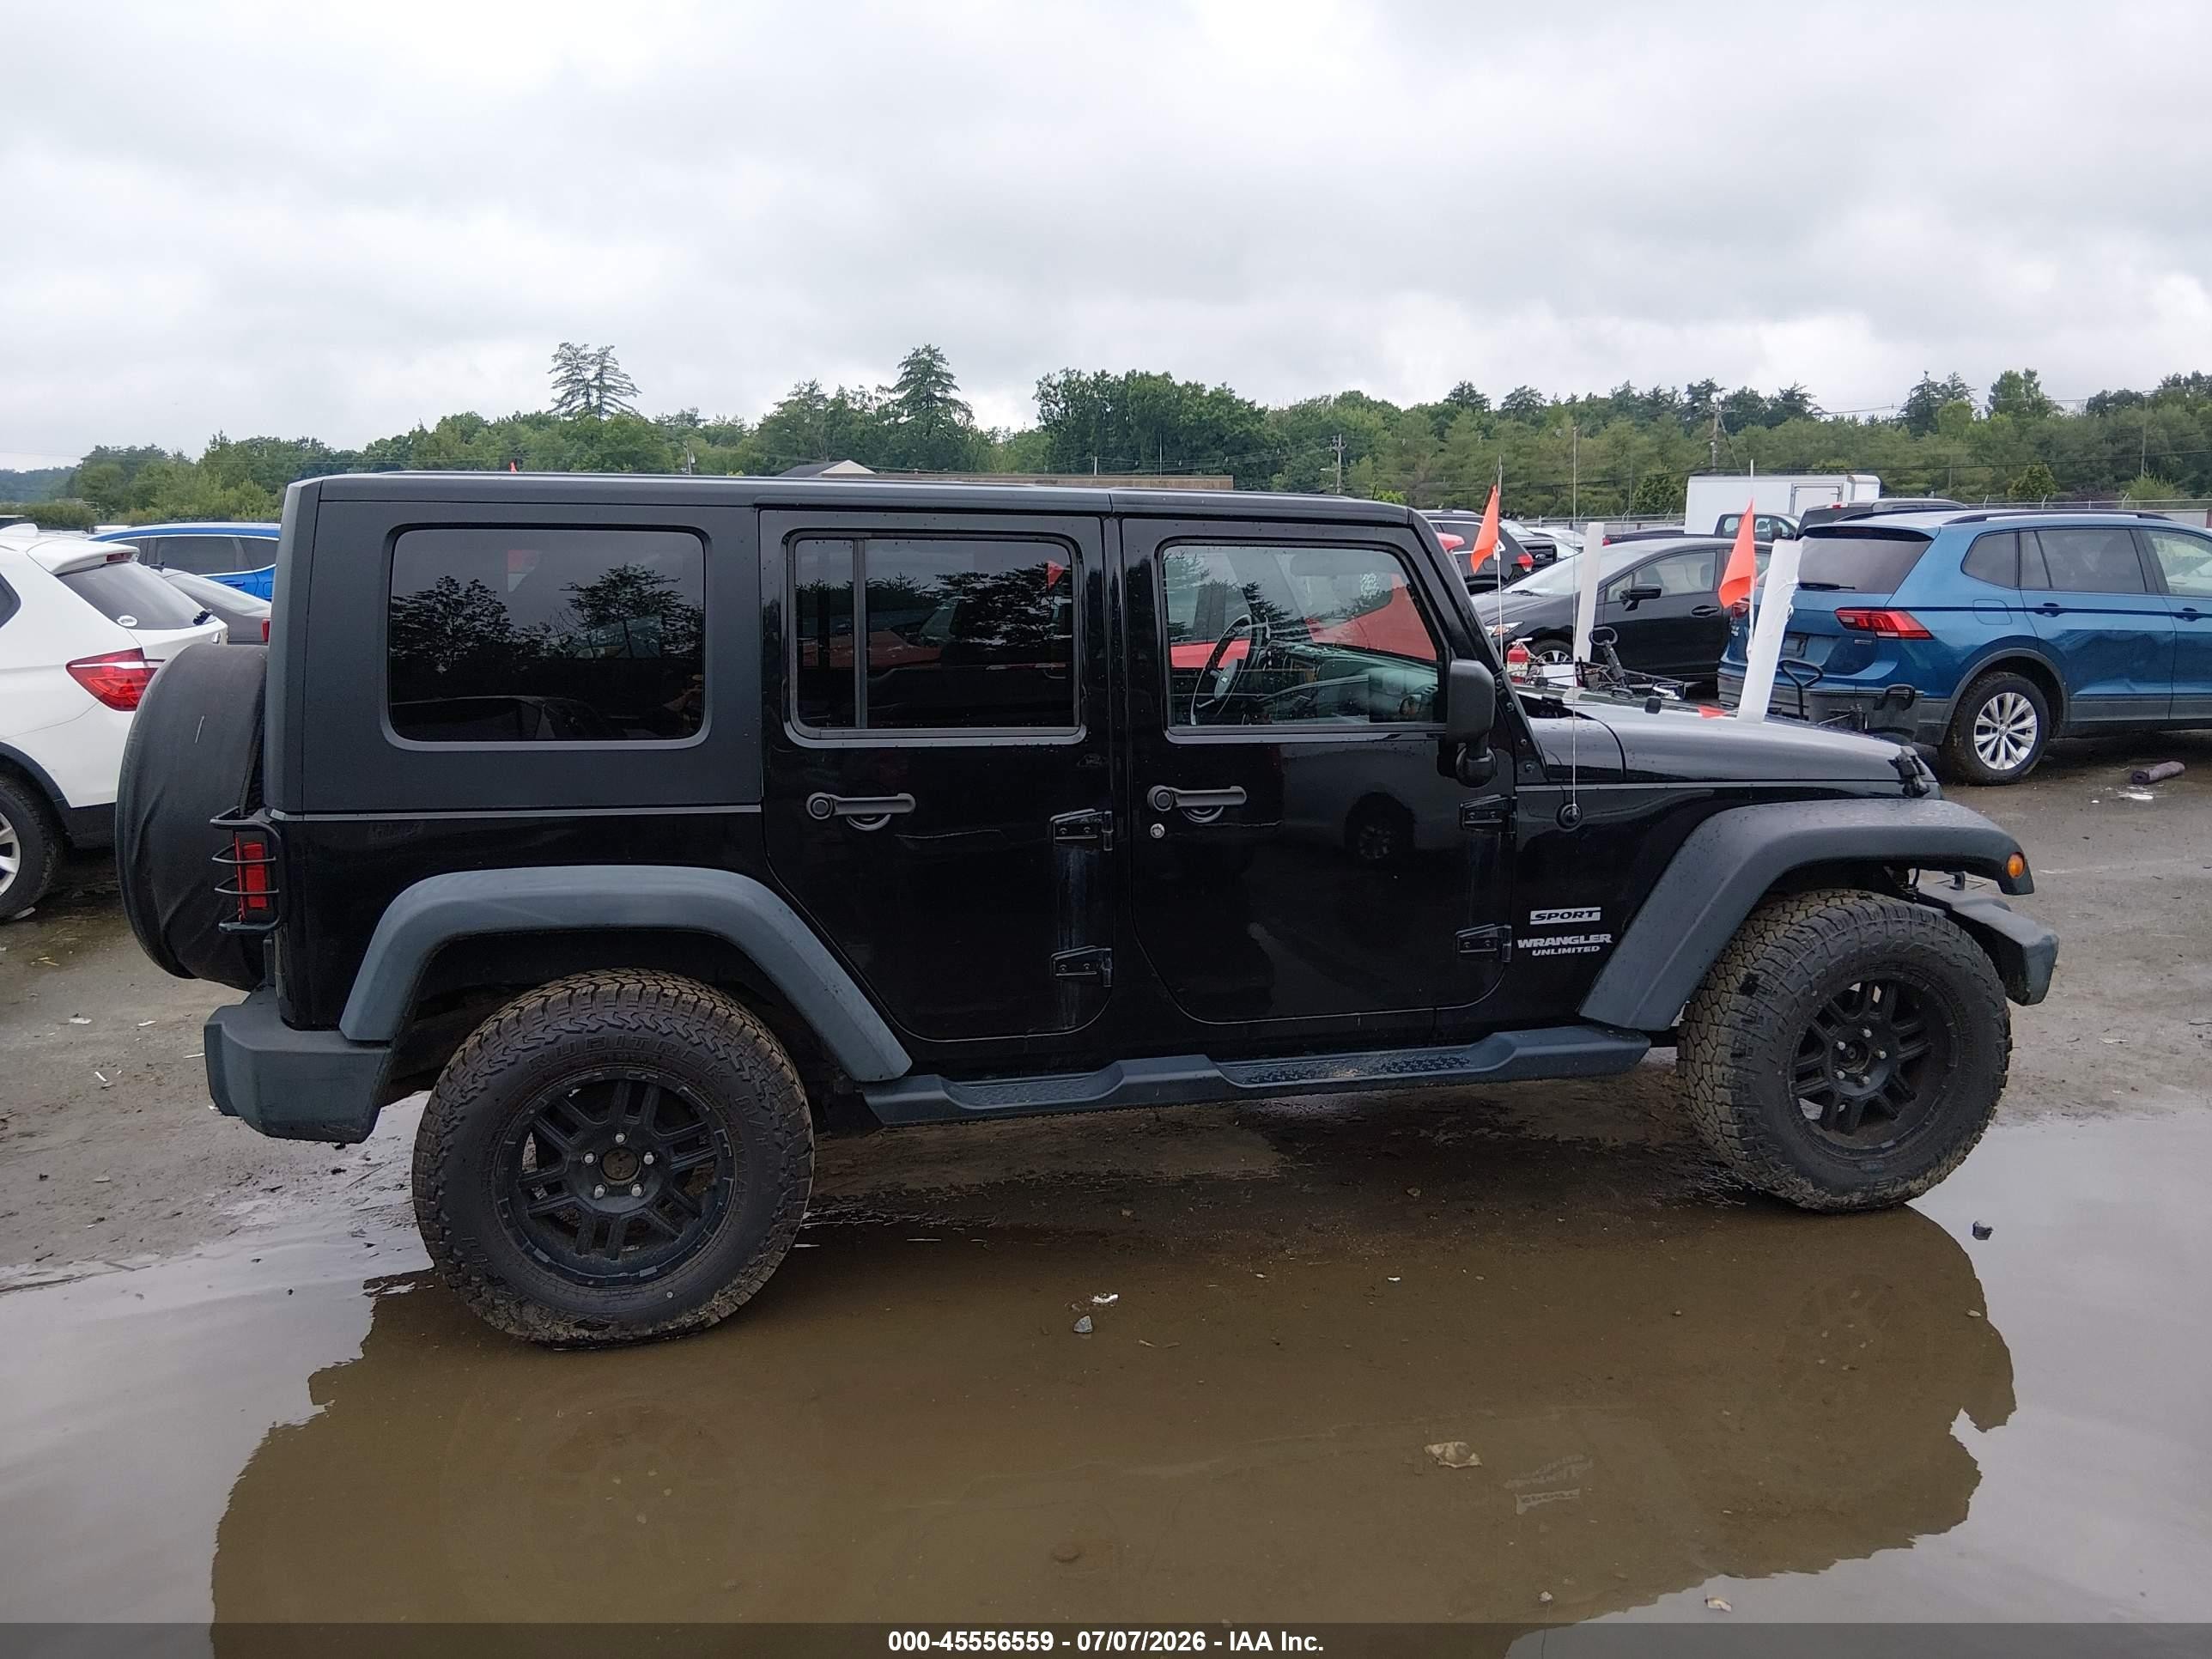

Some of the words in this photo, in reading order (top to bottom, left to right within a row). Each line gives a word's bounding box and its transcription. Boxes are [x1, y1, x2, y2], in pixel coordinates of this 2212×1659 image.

[1532, 909, 1601, 922] SPORT
[1517, 933, 1613, 949] WRANGLER
[1532, 945, 1600, 957] UNLIMITED
